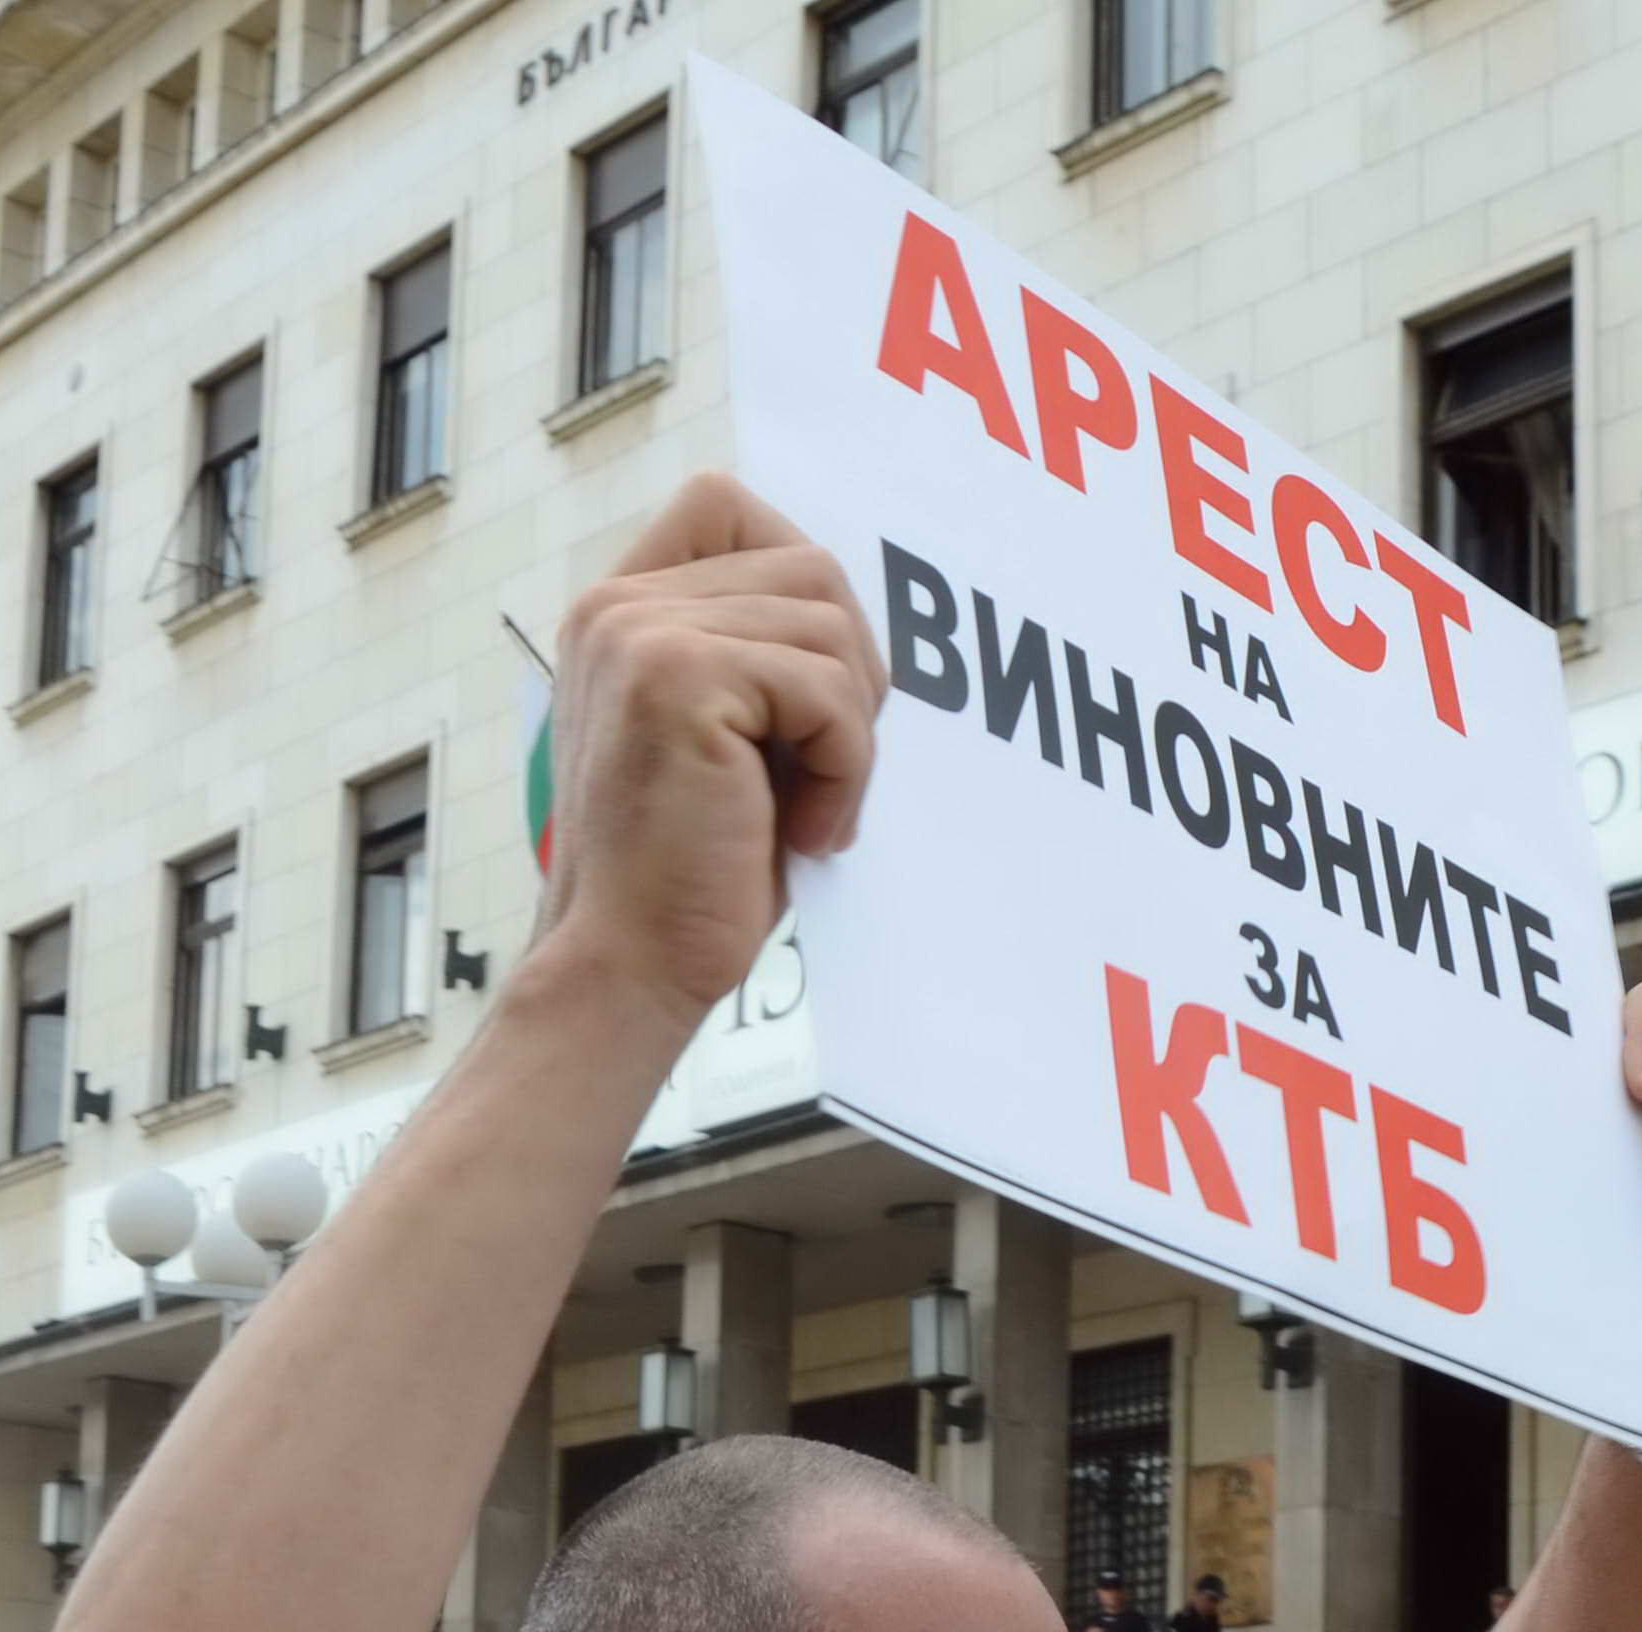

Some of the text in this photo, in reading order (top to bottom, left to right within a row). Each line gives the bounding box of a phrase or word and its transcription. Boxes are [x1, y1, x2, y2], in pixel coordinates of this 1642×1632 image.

[517, 0, 668, 107] БЪЛГА
[877, 211, 1472, 736] АРЕСТ
[1180, 592, 1291, 722] НА
[882, 539, 1572, 1037] ВИНОВНИТЕ
[1239, 922, 1343, 1041] ЗА
[1104, 964, 1487, 1316] КТБ
